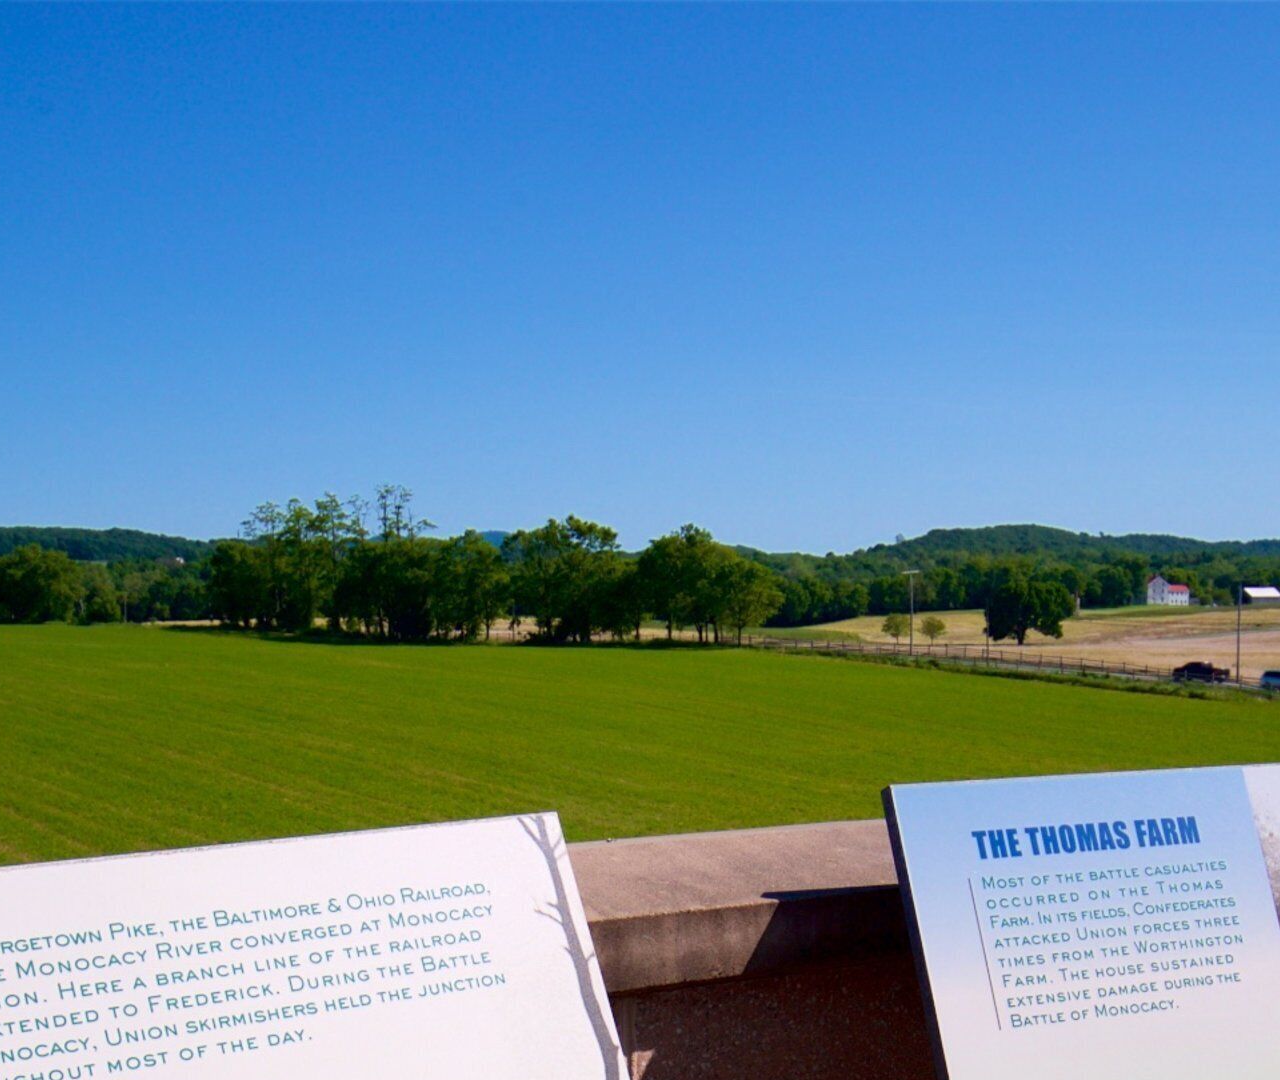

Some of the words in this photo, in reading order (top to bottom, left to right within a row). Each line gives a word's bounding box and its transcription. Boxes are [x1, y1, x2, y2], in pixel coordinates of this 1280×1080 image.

[971, 829, 1022, 859] THE
[1024, 821, 1130, 856] THOMAS
[1134, 816, 1200, 847] FARM
[981, 876, 1024, 889] MOST
[1030, 875, 1050, 886] OF
[1055, 872, 1084, 883] THE
[1088, 868, 1140, 881] BATTLE
[1144, 860, 1227, 877] CASUALTIES
[169, 917, 208, 932] THE
[212, 903, 322, 928] BALTIMORE
[327, 898, 342, 913] &
[346, 893, 395, 910] OHIO
[986, 892, 1079, 910] OCCURRED
[1088, 890, 1111, 901] ON
[1118, 886, 1149, 897] THE
[1155, 879, 1223, 894] THOMAS
[1037, 911, 1052, 924] IN
[1056, 911, 1077, 922] ITS
[1132, 897, 1236, 916] CONFEDERATES
[15, 950, 147, 979] MONOCACY
[155, 940, 222, 960] RIVER
[230, 923, 352, 950] CONVERGED
[360, 919, 380, 933] AT
[388, 905, 492, 928] MONOCACY
[994, 932, 1071, 949] ATTACKED
[1076, 926, 1127, 941] UNION
[1133, 920, 1190, 935] FORCES
[1194, 915, 1240, 928] THREE
[57, 979, 123, 1000] HERE
[133, 977, 147, 990] A
[155, 963, 244, 986] BRANCH
[254, 954, 301, 972] LINE
[308, 950, 334, 965] OF
[342, 943, 381, 959] THE
[389, 930, 481, 953] RAILROAD
[997, 954, 1045, 968] TIMES
[1052, 949, 1094, 963] FROM
[1100, 946, 1130, 958] THE
[1133, 934, 1243, 954] WORTHINGTON
[1058, 968, 1090, 981] THE
[1095, 963, 1145, 978] HOUSE
[1150, 954, 1234, 972] SUSTAINED
[108, 1003, 138, 1019] TO
[287, 970, 370, 992] DURING
[376, 963, 414, 978] THE
[420, 952, 491, 973] BATTLE
[1007, 989, 1091, 1008] EXTENSIVE
[1097, 982, 1158, 998] DAMAGE
[1164, 975, 1214, 990] DURING
[1216, 972, 1241, 983] THE
[104, 1024, 178, 1046] UNION
[185, 1002, 318, 1034] SKIRMISHERS
[324, 994, 372, 1012] HELD
[376, 987, 412, 1003] THE
[418, 973, 506, 998] JUNCTION
[1010, 1012, 1065, 1028] BATTLE
[1070, 1009, 1088, 1021] OF
[107, 1051, 168, 1073] MOST
[179, 1045, 207, 1061] OF
[216, 1037, 259, 1054] THE
